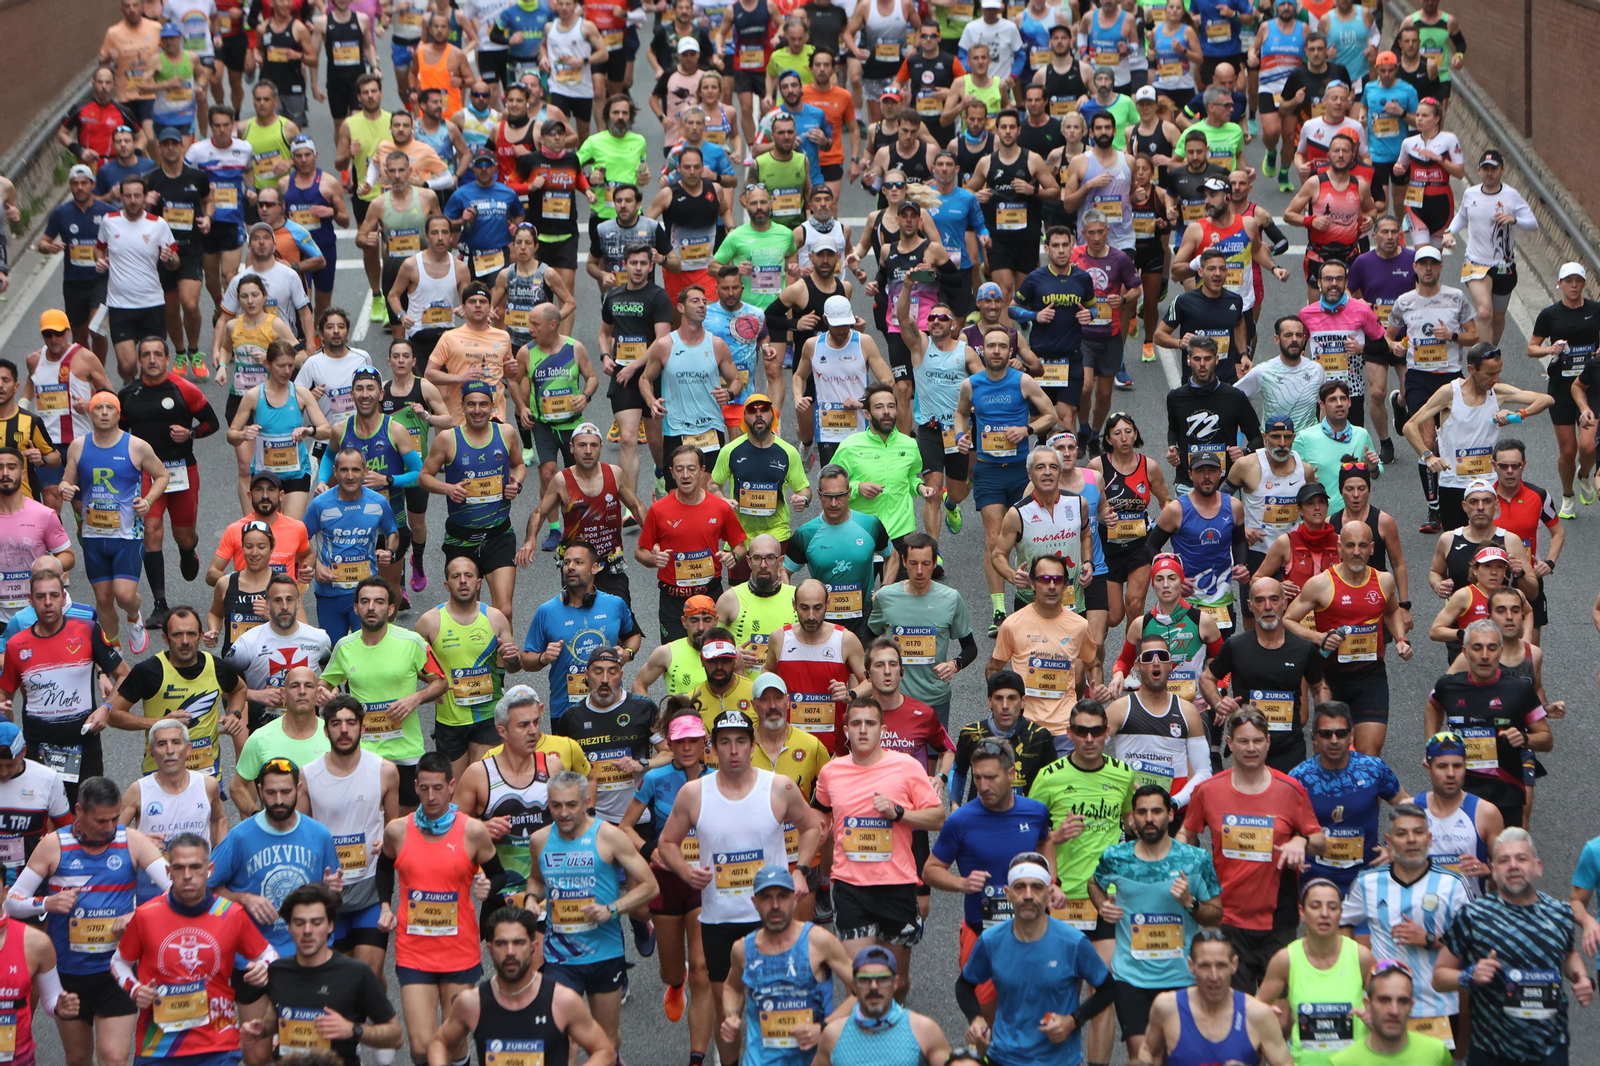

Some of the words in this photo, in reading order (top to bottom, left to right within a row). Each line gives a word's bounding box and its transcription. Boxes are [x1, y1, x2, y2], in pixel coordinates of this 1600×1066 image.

[1042, 294, 1081, 304] UBUNTU
[611, 305, 644, 313] CHICAGO
[535, 367, 546, 378] Las
[548, 368, 569, 379] Tablas
[552, 388, 570, 396] ZURICH
[478, 469, 499, 478] ZURICH
[93, 468, 119, 494] R
[752, 482, 774, 490] ZURICH
[1120, 512, 1141, 520] ZURICH
[333, 528, 371, 536] Rafal
[333, 536, 369, 545] Running
[1033, 531, 1077, 543] maratón
[686, 550, 708, 559] ZURICH
[344, 566, 358, 574] 6105
[6, 571, 29, 580] ZURICH
[835, 595, 849, 603] 5053
[907, 627, 931, 635] ZURICH
[1043, 661, 1066, 669] ZURICH
[467, 666, 487, 676] ZURICH
[30, 674, 59, 692] Simón
[167, 684, 188, 692] Mercury
[880, 738, 914, 748] ARATÓN
[600, 750, 626, 759] ZURICH
[1144, 764, 1169, 775] ZURICH
[10, 815, 31, 828] TRI
[168, 821, 204, 830] CALIFATO
[860, 819, 887, 827] ZURICH
[1240, 818, 1268, 826] ZURICH
[333, 835, 360, 845] ZURICH
[730, 852, 758, 861] ZURICH
[566, 857, 593, 866] ULSA
[426, 893, 453, 901] ZURICH
[562, 890, 588, 898] ZURICH
[88, 909, 116, 917] ZURICH
[1525, 971, 1555, 980] ZURICH
[170, 982, 199, 994] ZURICH
[777, 1001, 806, 1009] ZURICH
[1317, 1004, 1348, 1013] ZURICH
[506, 1042, 537, 1051] ZURICH
